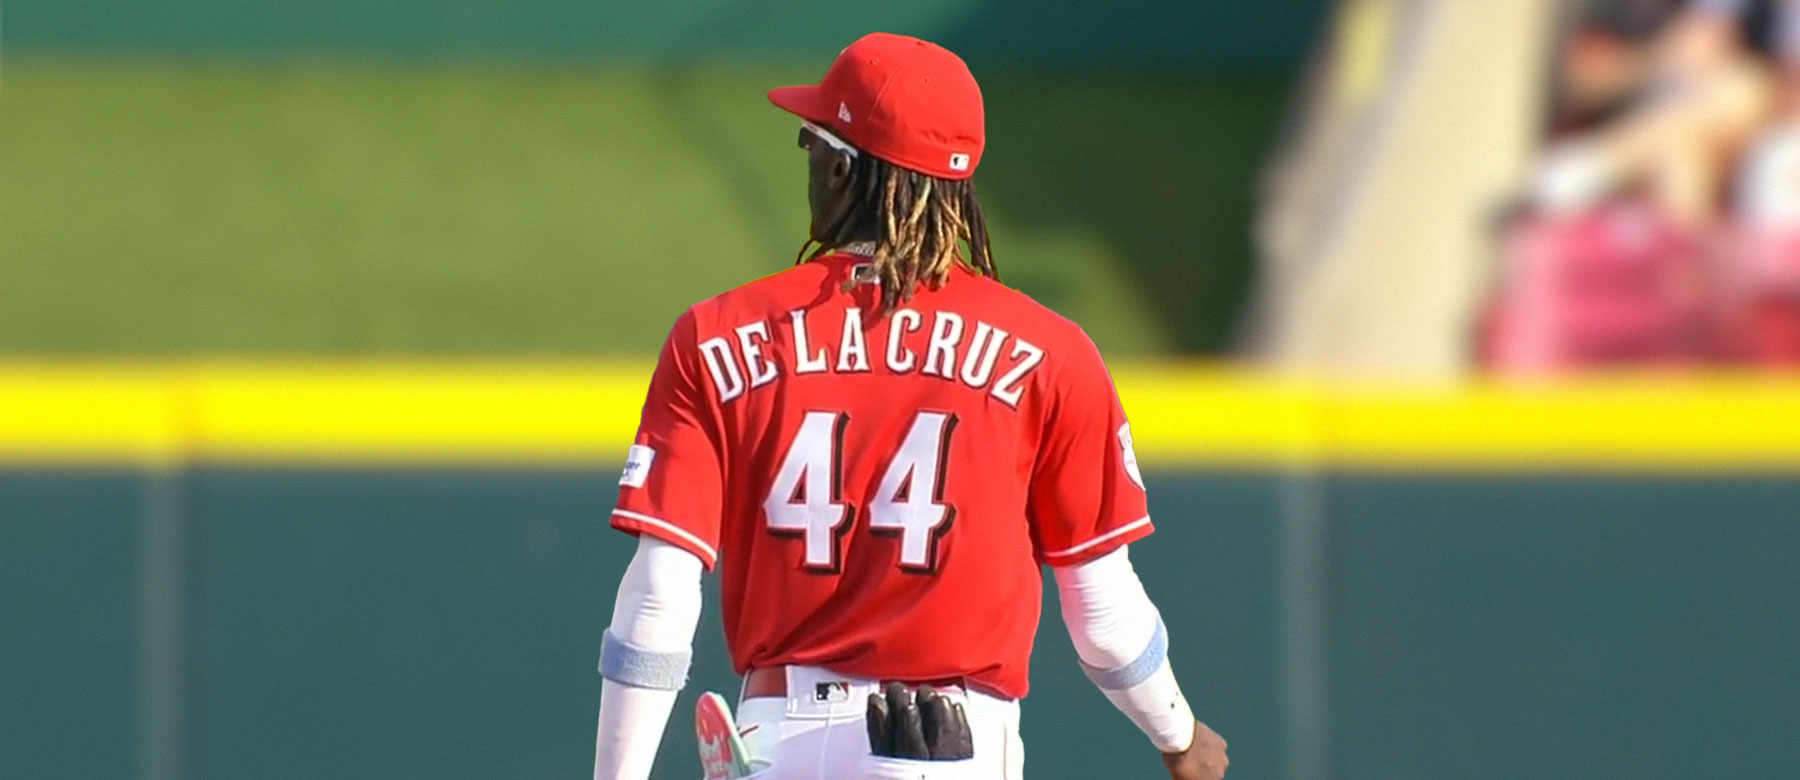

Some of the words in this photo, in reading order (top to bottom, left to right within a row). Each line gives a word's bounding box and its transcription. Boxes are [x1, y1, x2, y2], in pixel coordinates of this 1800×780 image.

[697, 320, 779, 405] DE
[788, 307, 871, 374] LA
[884, 307, 1046, 410] CRUZ
[762, 409, 960, 575] 44
